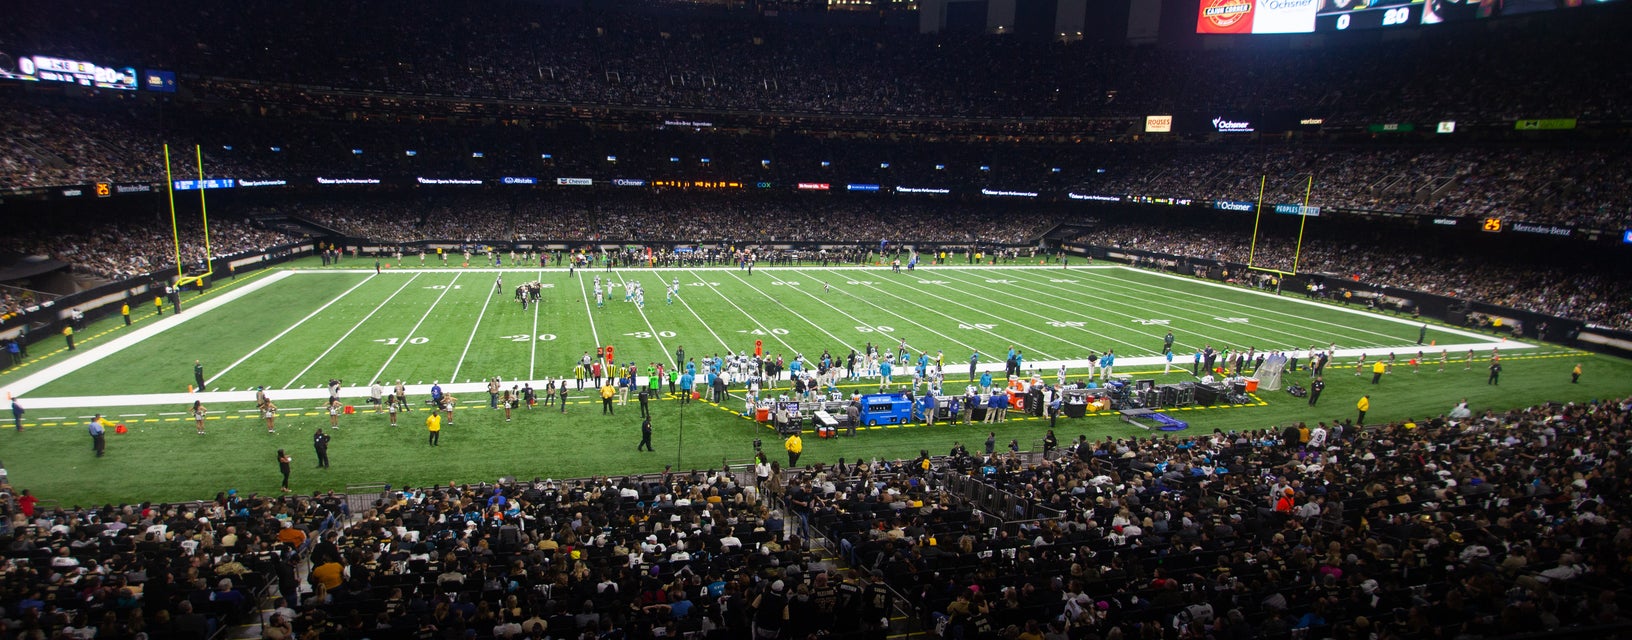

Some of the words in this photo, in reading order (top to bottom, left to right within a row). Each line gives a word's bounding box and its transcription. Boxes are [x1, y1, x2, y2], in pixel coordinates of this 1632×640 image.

[1336, 13, 1351, 30] 0
[1382, 7, 1410, 26] 20
[1218, 120, 1249, 129] Ochsner
[97, 183, 110, 196] 25
[1221, 201, 1251, 212] Ochsner
[1276, 204, 1298, 214] PEOPLES
[1484, 218, 1501, 231] 25
[1512, 223, 1571, 236] Mercedes-Benz
[512, 334, 557, 342] 20
[634, 330, 677, 338] 30
[383, 337, 430, 345] 10
[1016, 399, 1024, 408] G
